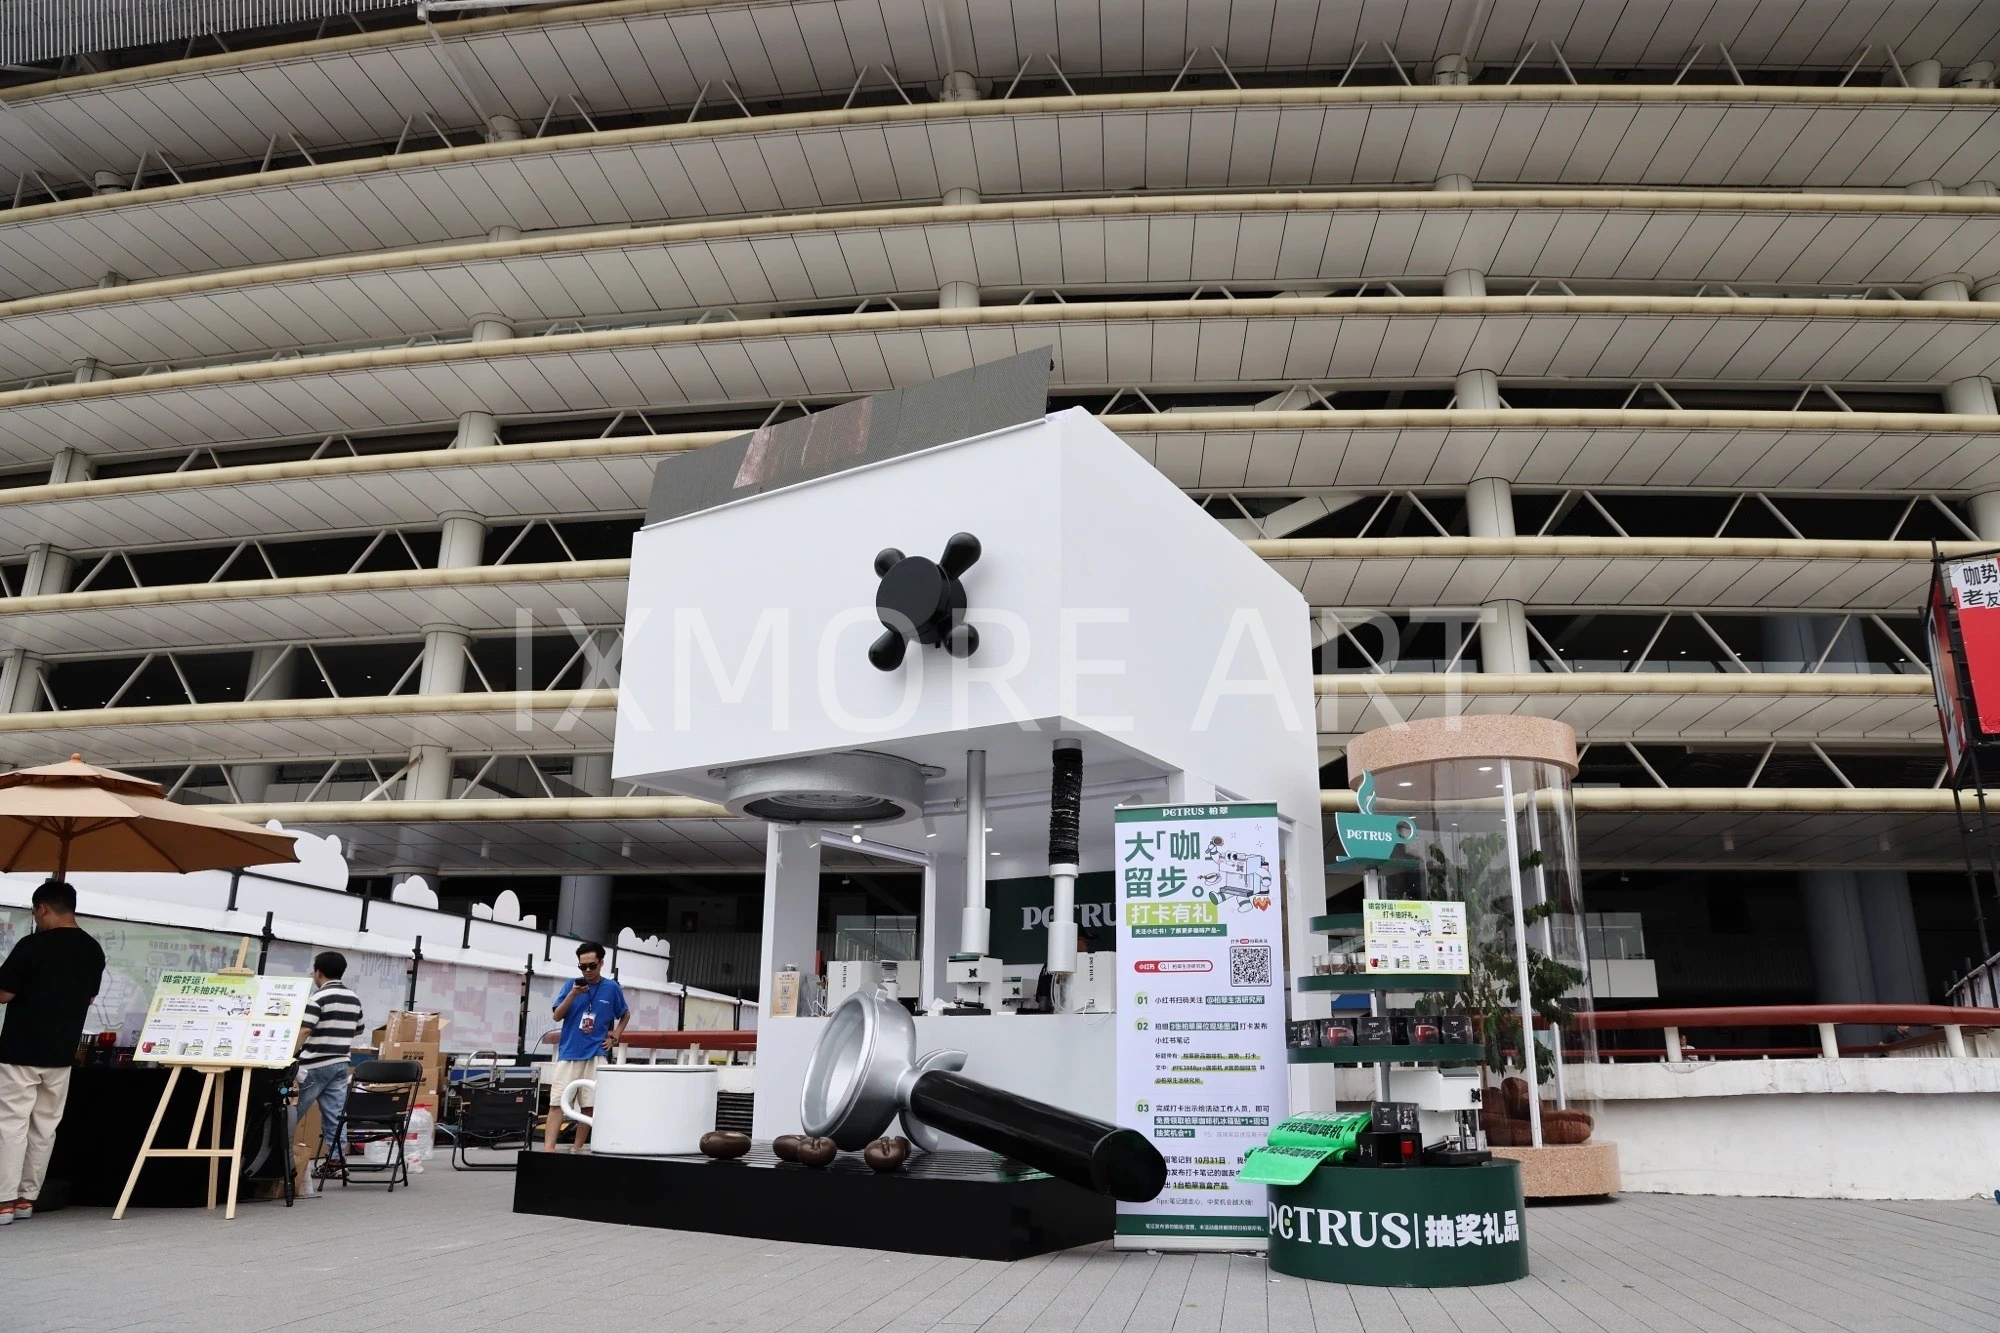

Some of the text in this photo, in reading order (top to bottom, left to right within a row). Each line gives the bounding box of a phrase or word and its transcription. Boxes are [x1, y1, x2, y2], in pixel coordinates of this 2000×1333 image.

[1963, 563, 1997, 585] 咖势
[1962, 589, 2000, 608] 老友
[1162, 807, 1205, 817] PETRUS
[1346, 828, 1393, 842] PETRUS
[1124, 865, 1205, 899] 留步。
[1021, 902, 1116, 931] PRU
[1131, 903, 1213, 924] 打卡有礼
[1137, 997, 1148, 1005] 01
[1137, 1022, 1149, 1030] 02
[1154, 1036, 1190, 1044] 小红书笔记
[1137, 1105, 1149, 1113] 03
[1268, 1200, 1520, 1249] PETRUS 抽奖礼品
